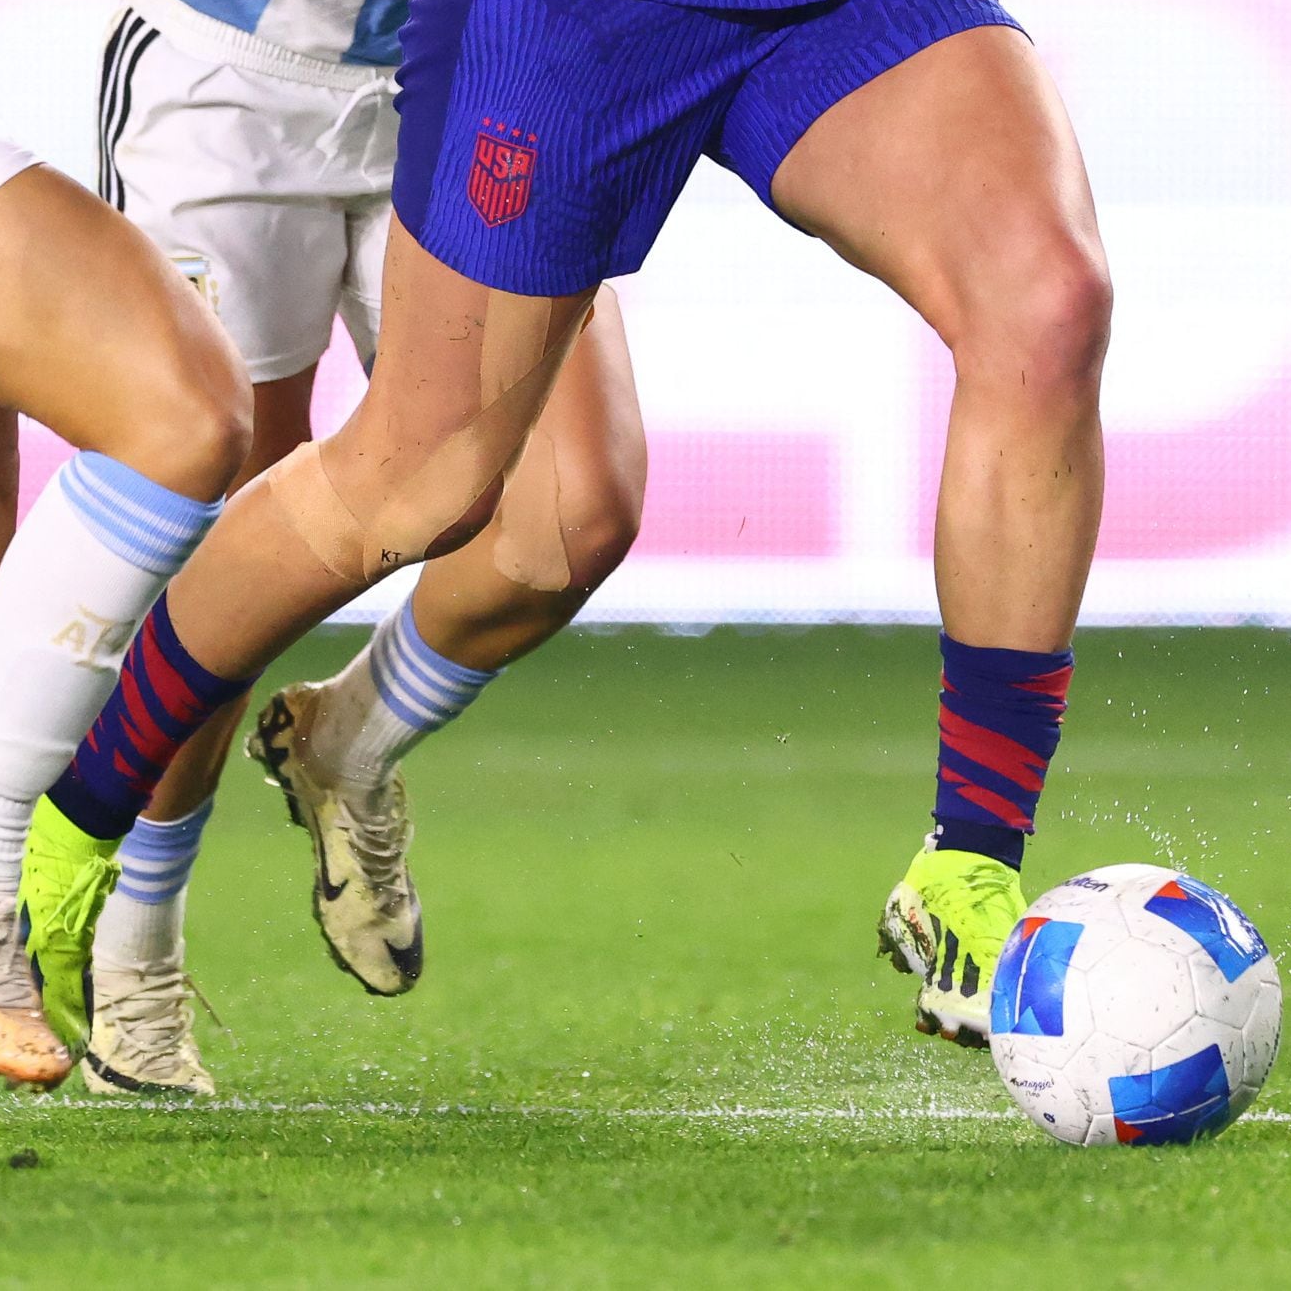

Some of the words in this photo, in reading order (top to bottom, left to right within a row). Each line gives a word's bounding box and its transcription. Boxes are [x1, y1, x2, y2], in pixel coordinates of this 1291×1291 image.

[476, 139, 530, 179] USA
[381, 548, 402, 563] KT
[1063, 877, 1110, 893] olten
